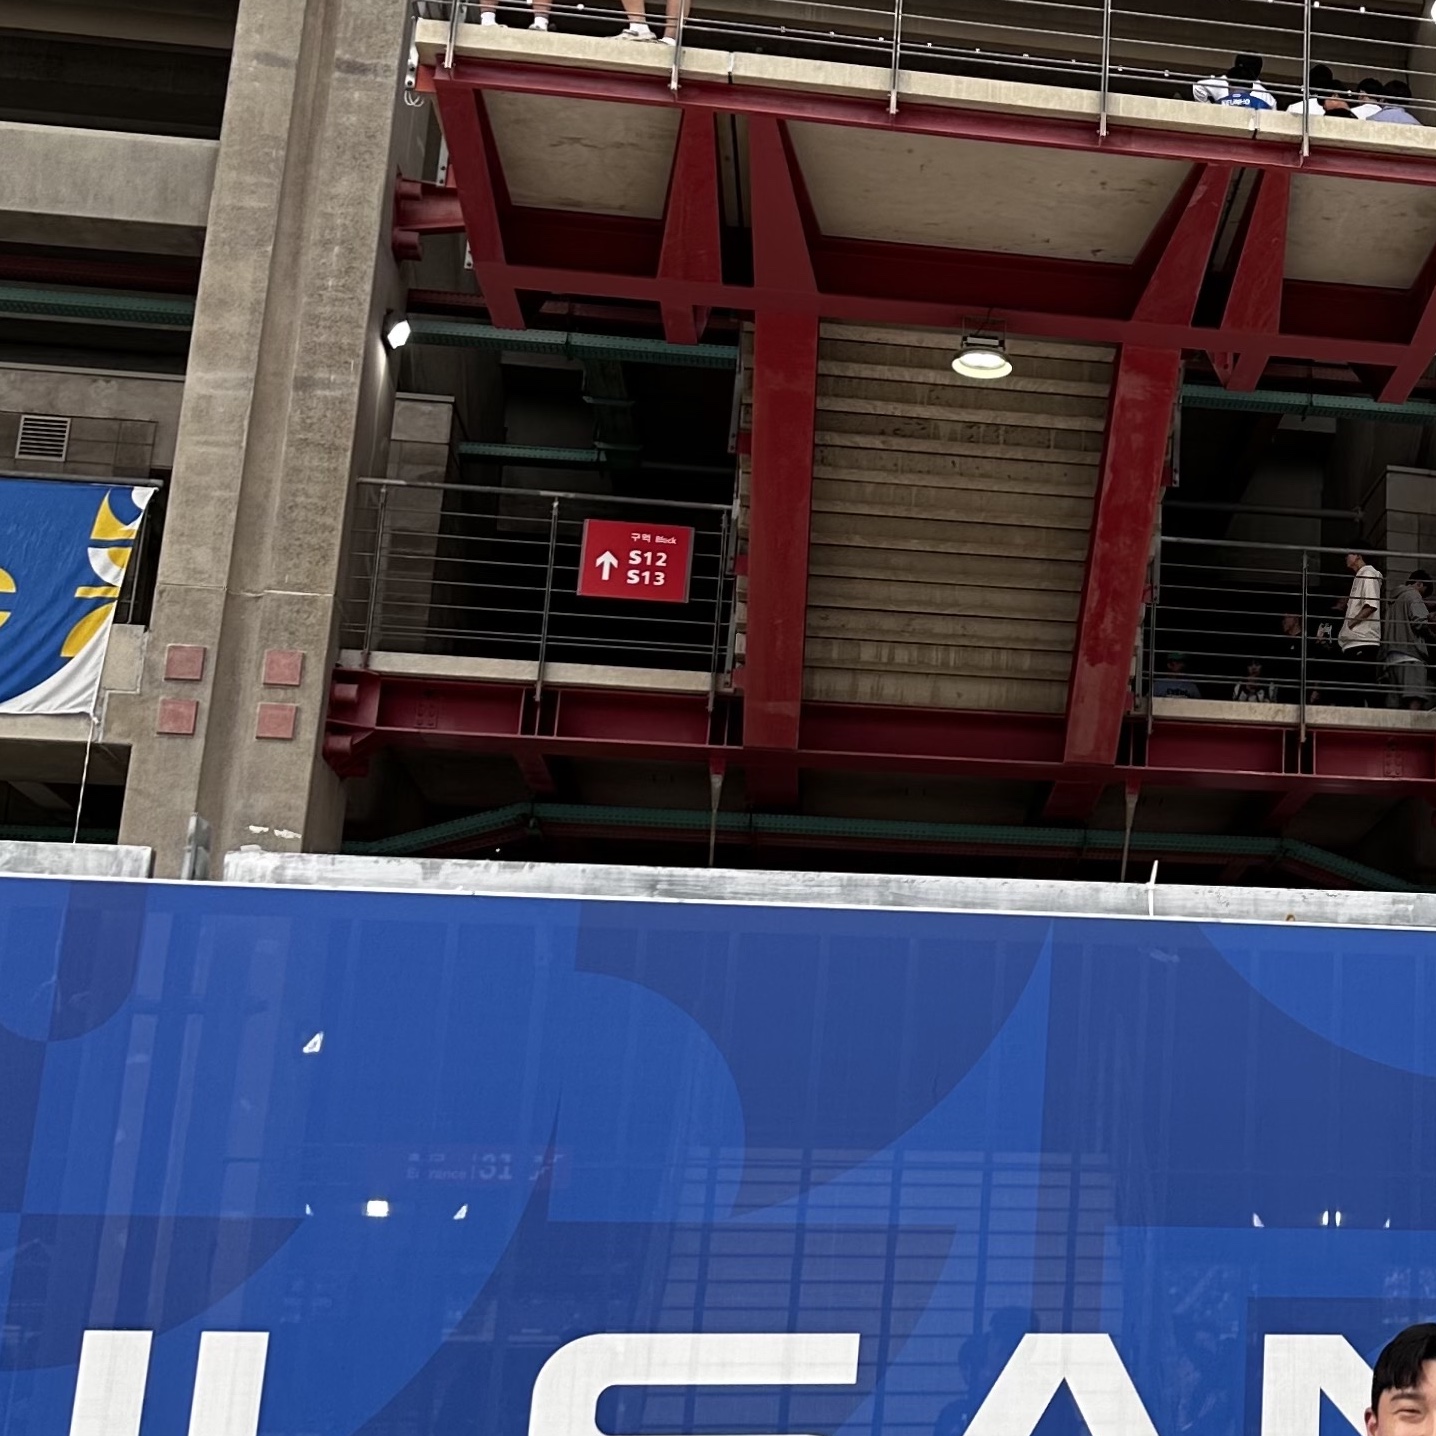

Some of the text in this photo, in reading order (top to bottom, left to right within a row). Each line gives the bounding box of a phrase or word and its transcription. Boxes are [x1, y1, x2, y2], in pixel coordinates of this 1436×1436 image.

[628, 549, 668, 567] S12
[626, 569, 666, 586] S13
[405, 1166, 467, 1181] Erance
